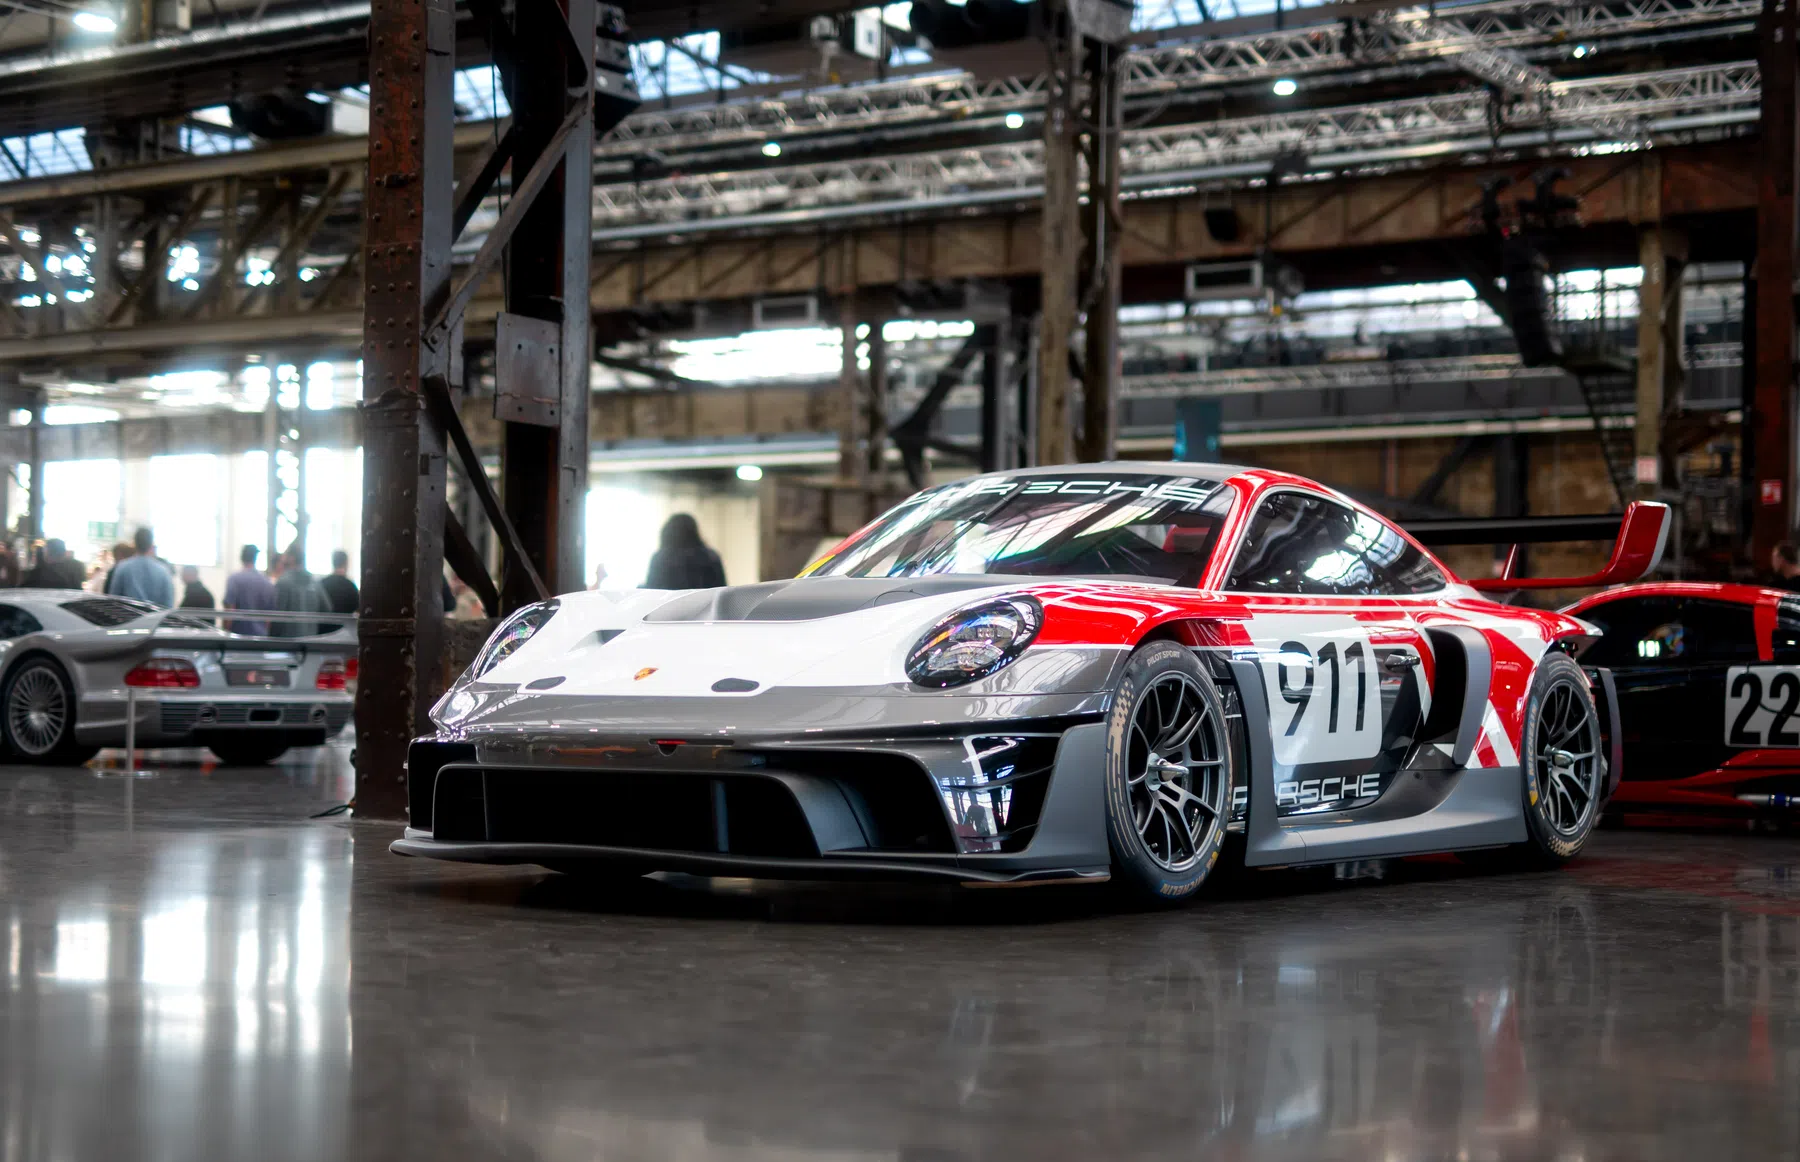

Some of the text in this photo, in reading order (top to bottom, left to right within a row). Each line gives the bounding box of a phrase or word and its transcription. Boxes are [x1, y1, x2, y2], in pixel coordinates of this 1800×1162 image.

[1146, 650, 1181, 667] PILOT SPORT
[1278, 641, 1366, 736] 911
[1528, 703, 1538, 776] MICHELIN
[1729, 672, 1800, 746] 22
[1232, 773, 1381, 810] PRSCHE
